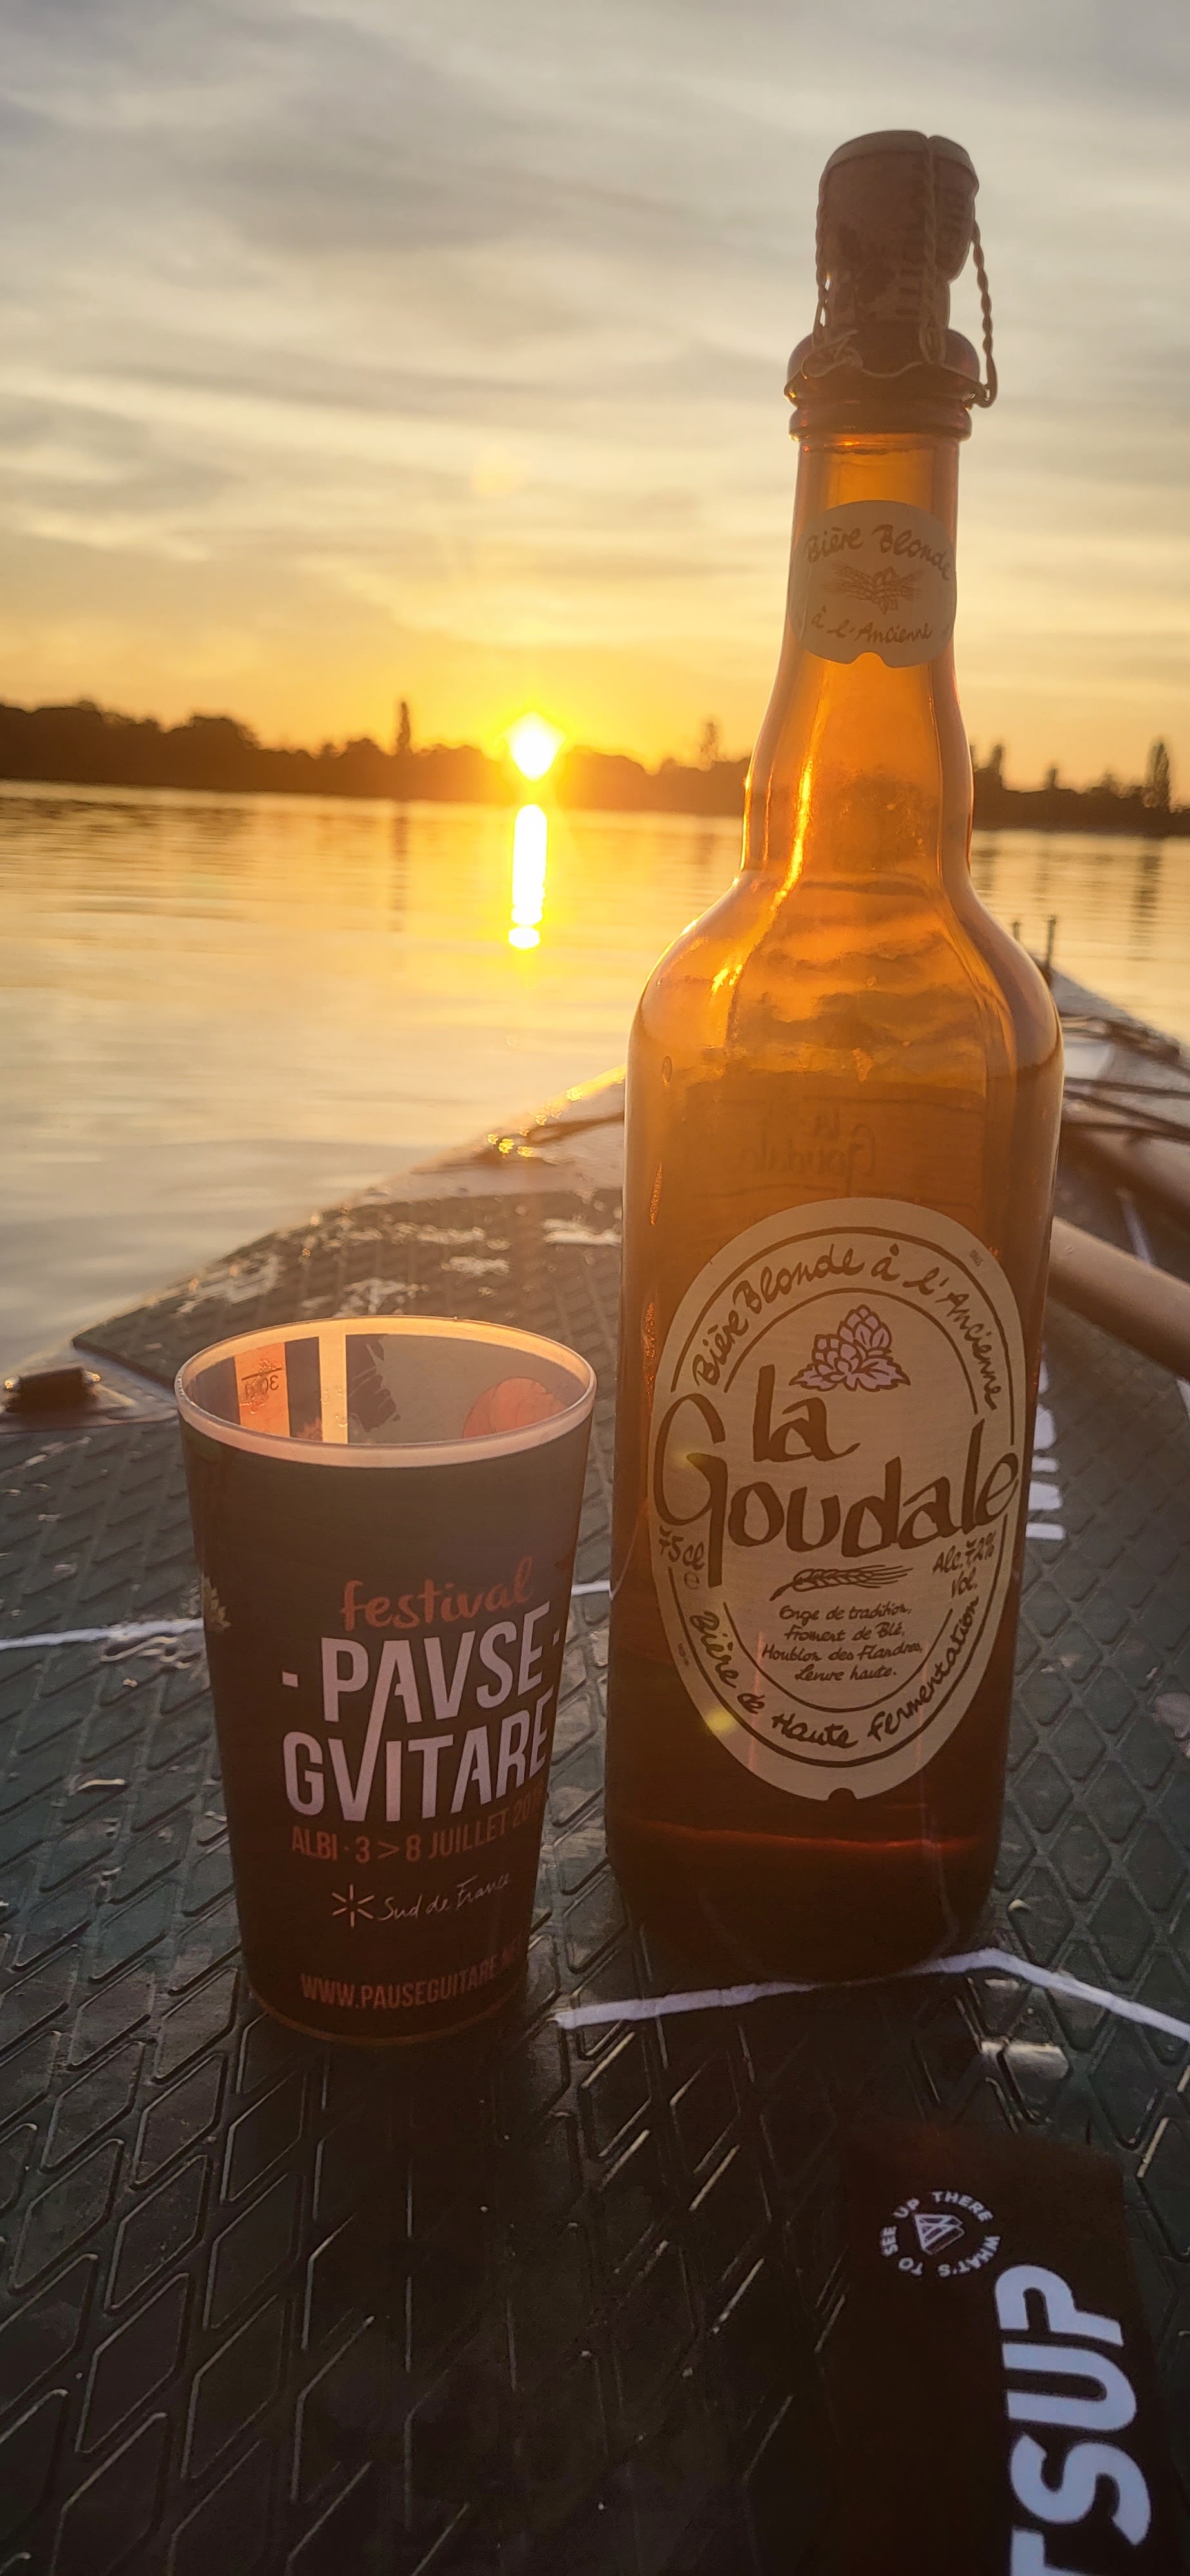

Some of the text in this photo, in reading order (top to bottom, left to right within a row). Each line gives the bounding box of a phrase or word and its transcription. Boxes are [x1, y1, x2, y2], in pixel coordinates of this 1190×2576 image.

[871, 524, 950, 581] Blonde
[732, 1244, 865, 1314] Blonde
[871, 1244, 900, 1282] à
[653, 1392, 1019, 1588] Goudale
[341, 1556, 533, 1631] festival
[826, 1606, 844, 1620] de
[762, 1643, 822, 1662] Houblon
[828, 1647, 854, 1661] des
[852, 1626, 871, 1640] de
[689, 1611, 739, 1688] Bière
[737, 1693, 765, 1714] de
[771, 1713, 858, 1748] Haute
[795, 1663, 844, 1681] Levure
[292, 1826, 339, 1861] ALBI
[355, 1835, 371, 1864] 3
[405, 1833, 422, 1863] 8
[427, 1807, 509, 1860] JUILLET
[377, 1872, 511, 1922] Sud de France
[881, 2190, 1001, 2278] WHAT'S TO SEE UP THERE
